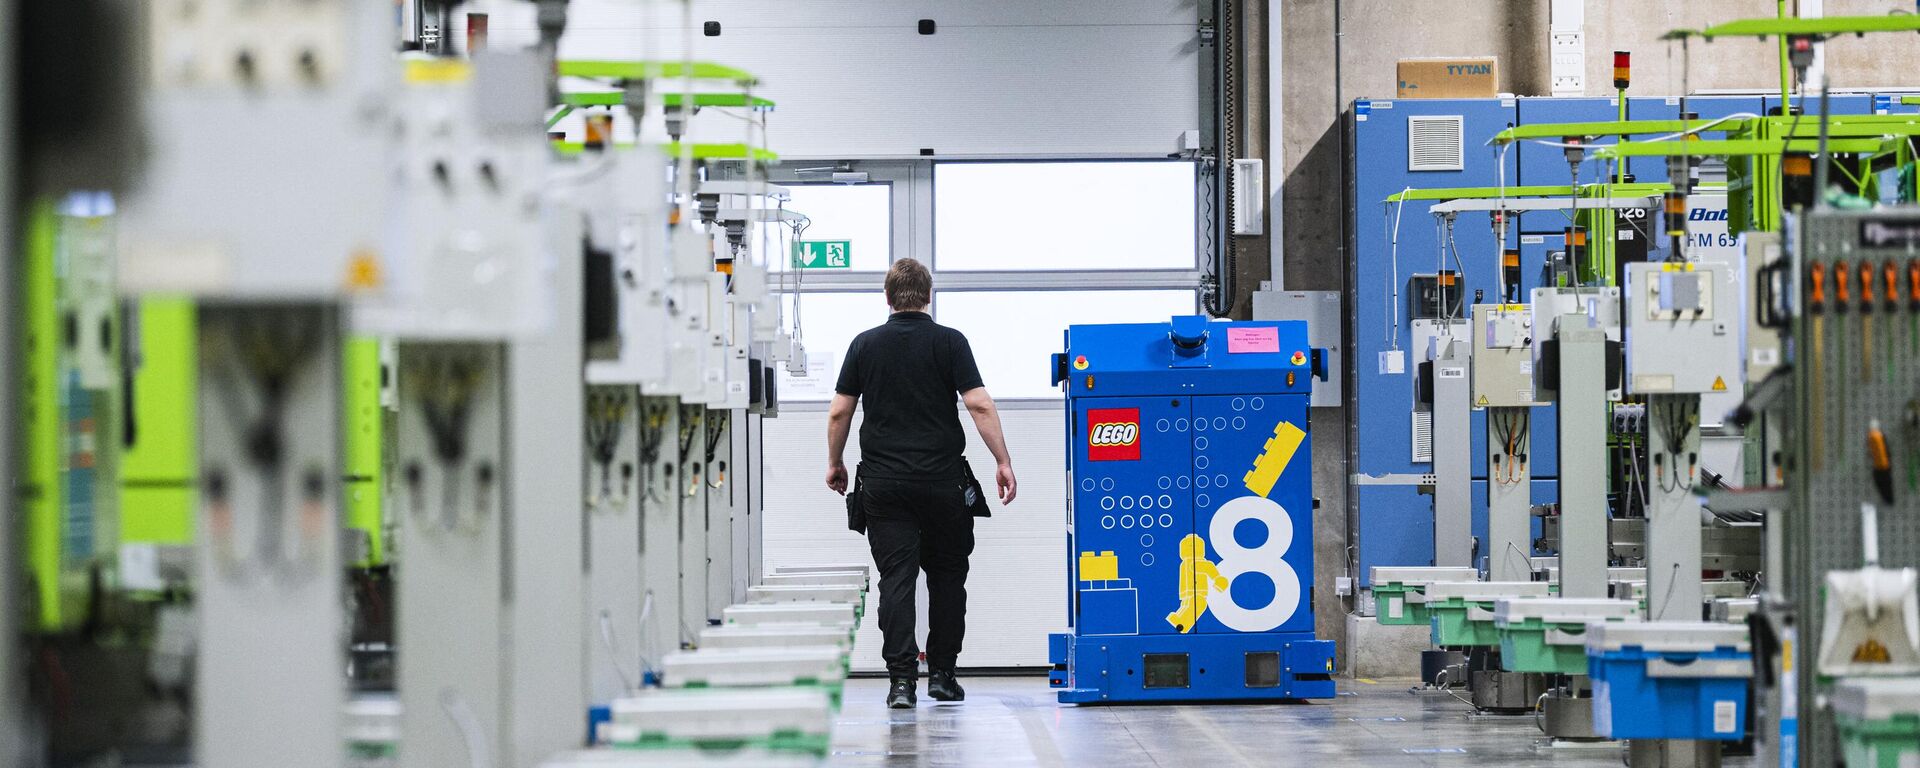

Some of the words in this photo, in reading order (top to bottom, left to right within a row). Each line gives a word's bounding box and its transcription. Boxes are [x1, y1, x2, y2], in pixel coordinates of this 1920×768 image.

[1447, 64, 1491, 75] TYTAN
[1718, 233, 1740, 247] 65
[1091, 423, 1137, 445] LEGO
[1206, 496, 1300, 632] 8
